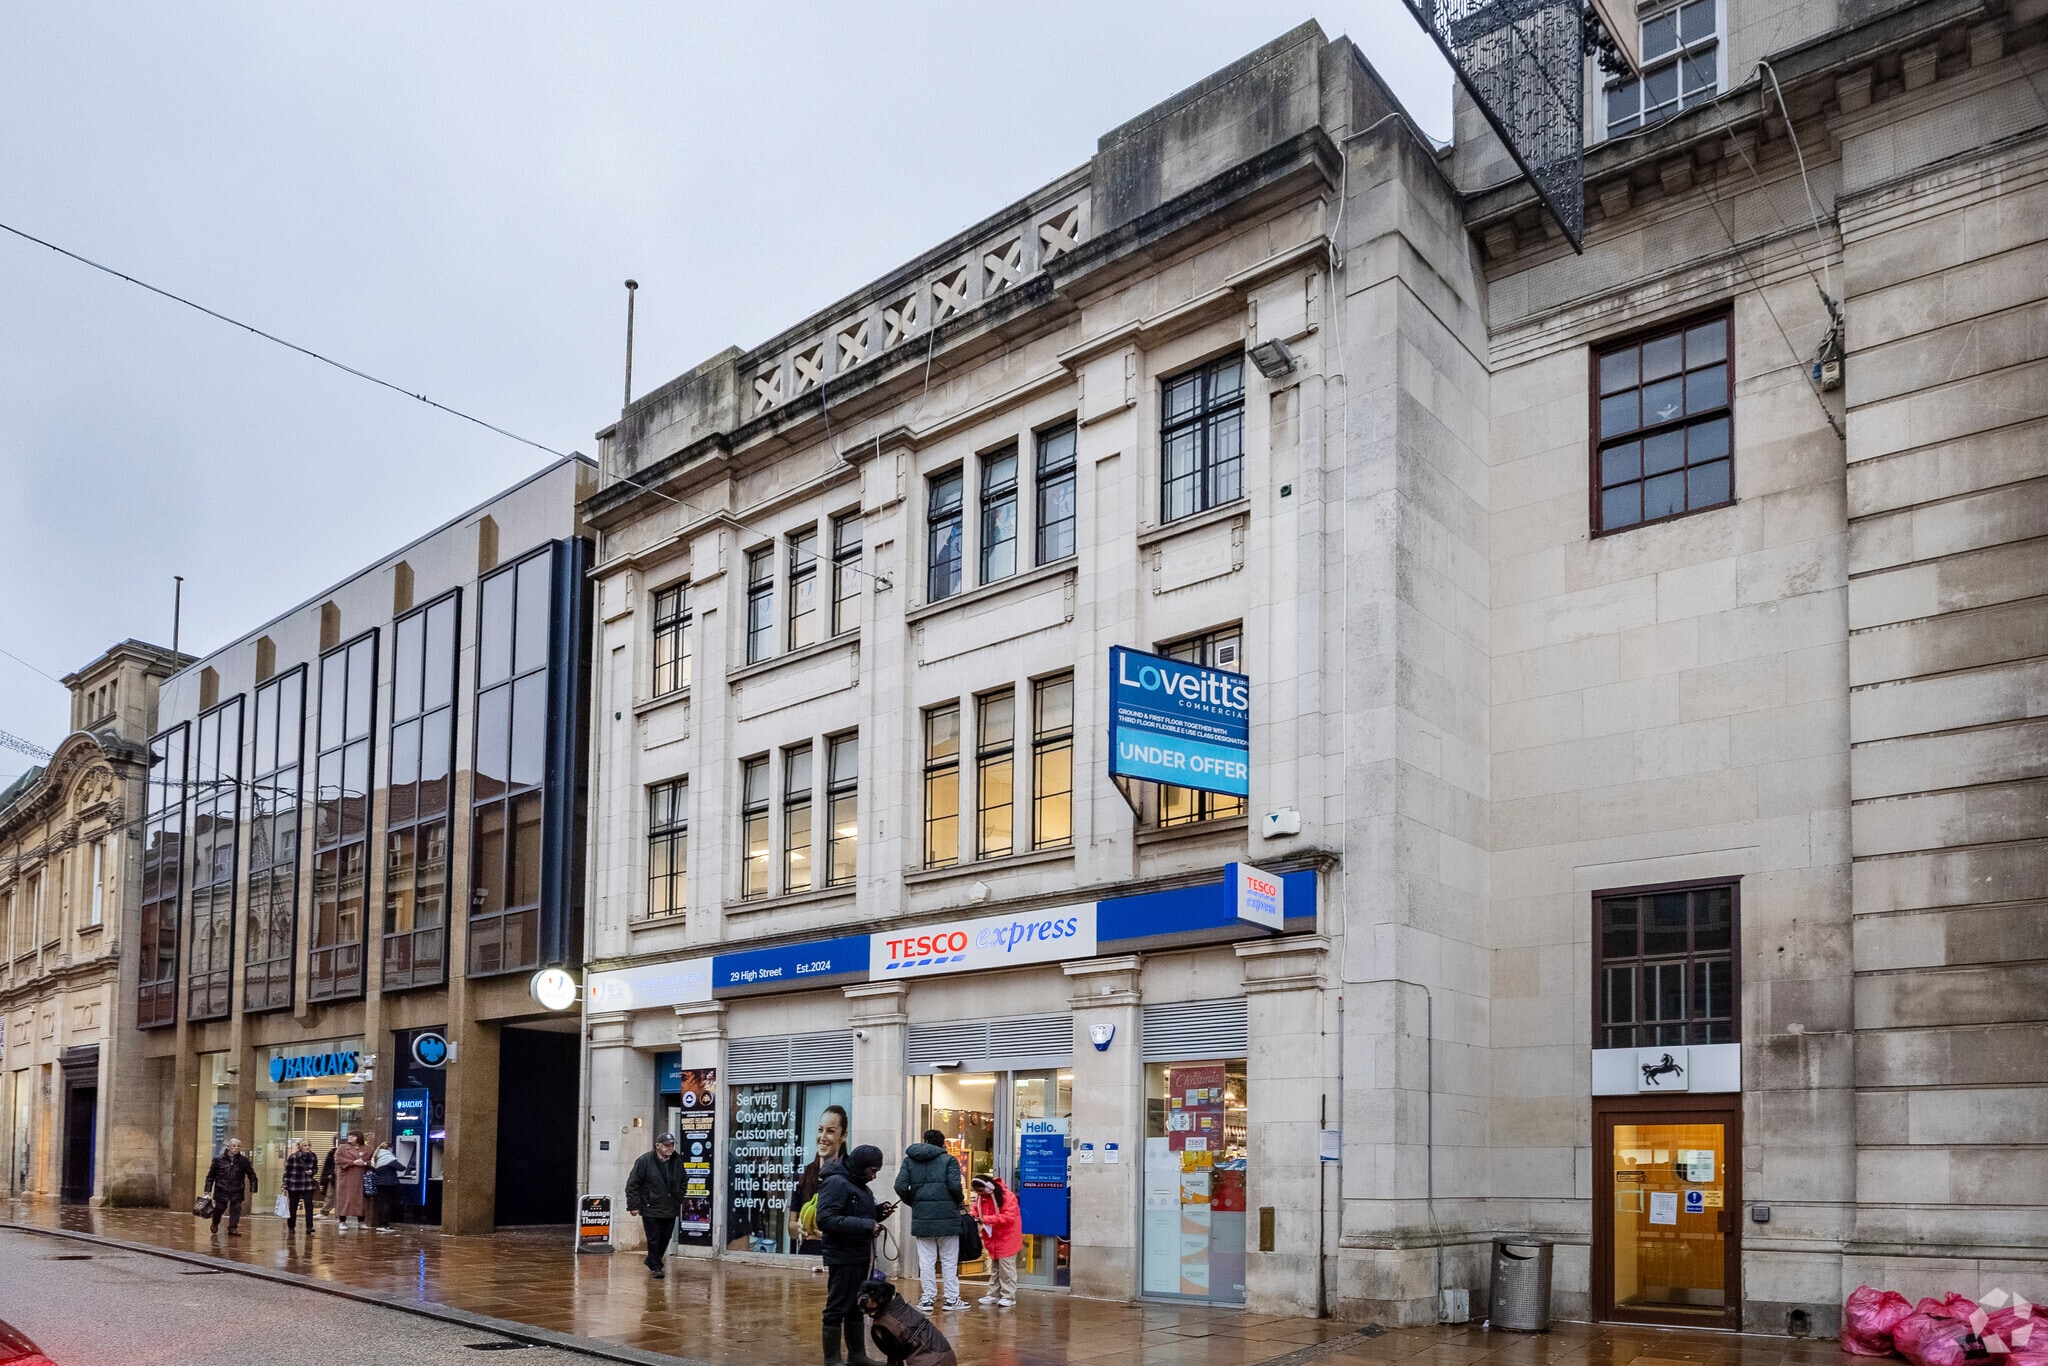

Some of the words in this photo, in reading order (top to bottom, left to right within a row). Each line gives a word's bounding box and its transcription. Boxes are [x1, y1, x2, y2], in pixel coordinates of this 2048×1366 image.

[1119, 652, 1248, 710] Loveitts
[1178, 700, 1248, 719] COMMERCIAL
[1118, 708, 1144, 719] GROUND
[1149, 714, 1165, 722] FIRST
[1165, 717, 1183, 726] FLOOR
[1183, 721, 1213, 732] TOGETHER
[1213, 726, 1228, 735] WITH
[1118, 715, 1137, 724] THIRD
[1137, 718, 1156, 727] FLOOR
[1156, 722, 1181, 733] FLEXIBLE
[1185, 728, 1196, 736] USE
[1196, 730, 1214, 740] CLASS
[1119, 742, 1186, 769] UNDER
[1190, 755, 1247, 780] OFFER
[1246, 876, 1276, 896] TESCO
[1246, 897, 1276, 915] express
[886, 931, 968, 960] TESCO
[976, 917, 1078, 953] express
[730, 972, 740, 981] 29
[741, 970, 757, 982] High
[759, 967, 782, 978] Street
[285, 1051, 359, 1079] BARCLAYS
[736, 1092, 777, 1108] Serving
[736, 1109, 796, 1125] Coventry's
[735, 1127, 798, 1141] customers,
[1026, 1121, 1056, 1133] Hello.
[735, 1143, 808, 1157] communities
[734, 1161, 756, 1174] and
[758, 1161, 794, 1177] planet
[797, 1164, 805, 1174] a
[734, 1177, 760, 1191] little
[762, 1177, 800, 1191] better
[734, 1196, 765, 1211] every
[768, 1196, 788, 1212] day
[581, 1209, 610, 1218] Massage
[581, 1217, 610, 1226] Therapy
